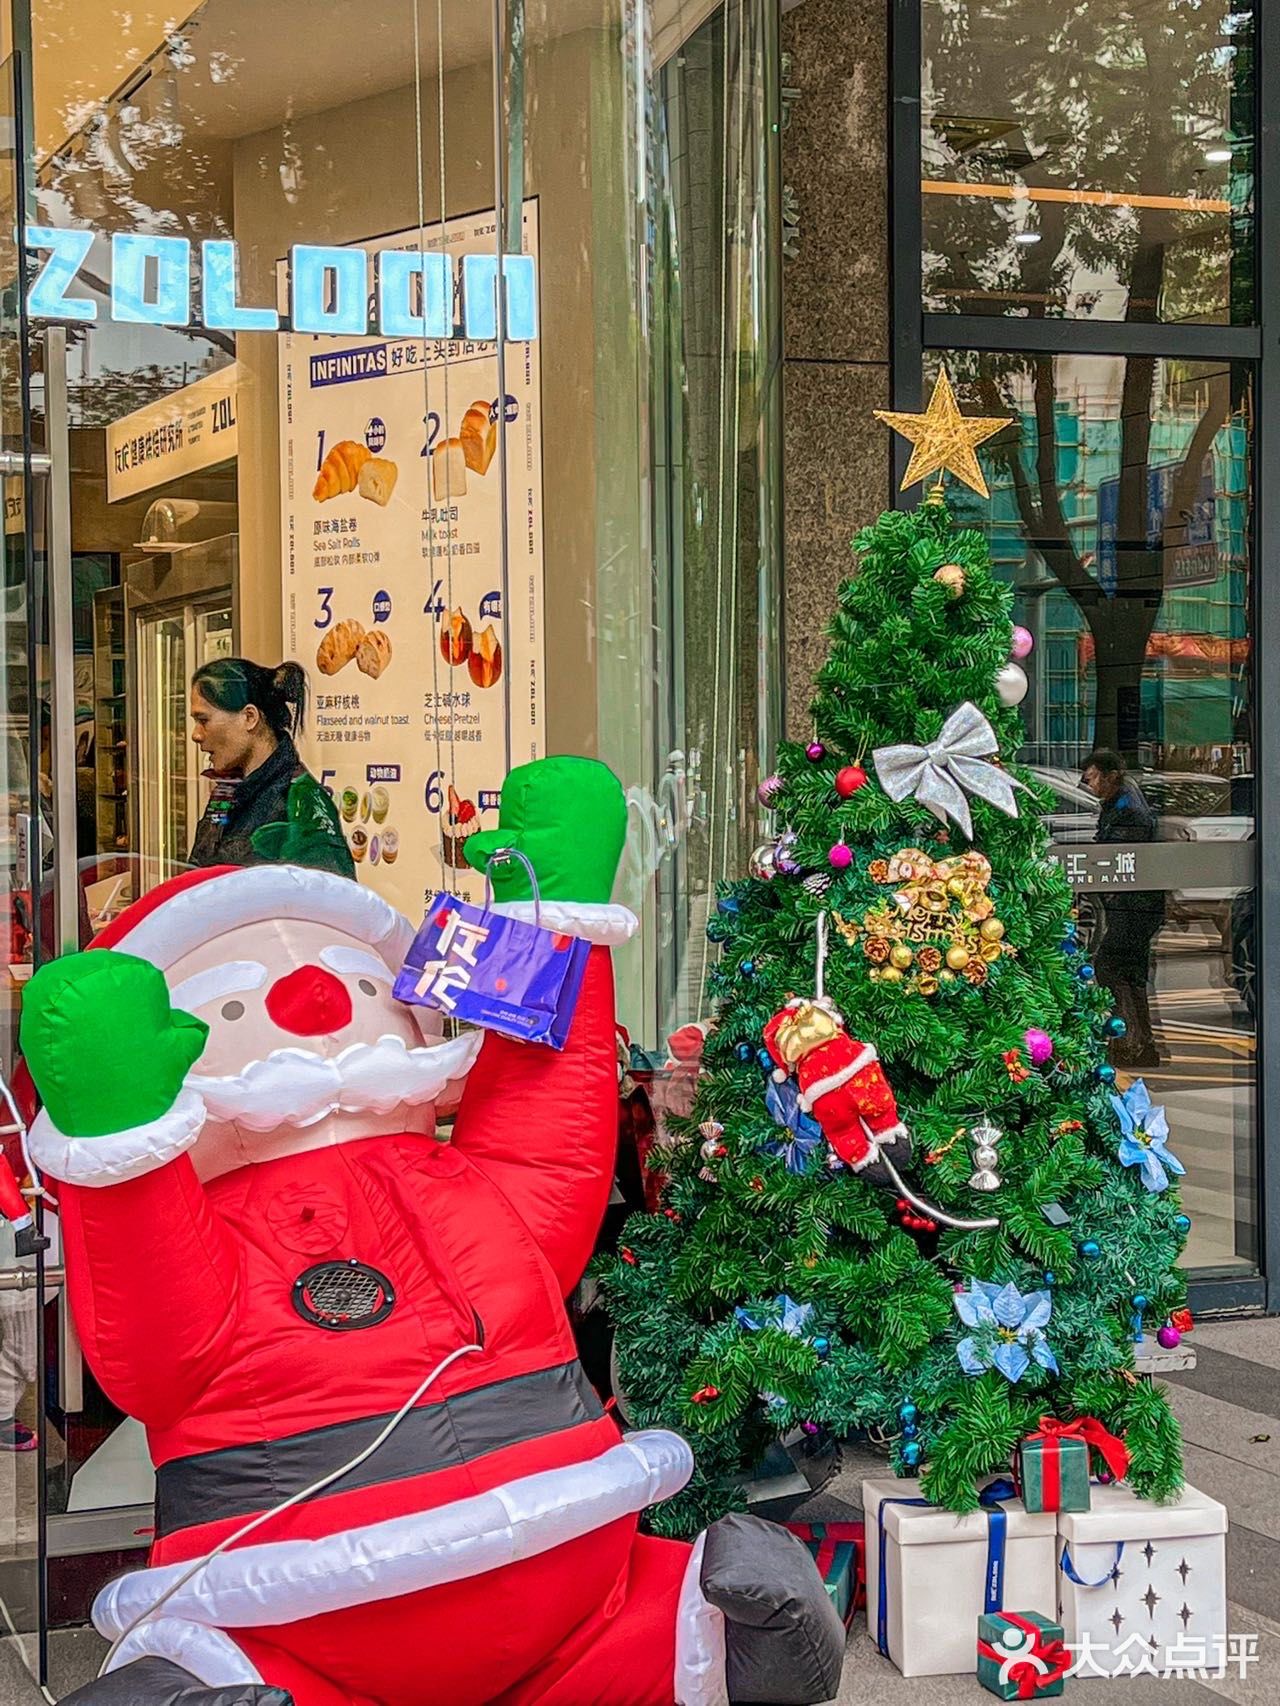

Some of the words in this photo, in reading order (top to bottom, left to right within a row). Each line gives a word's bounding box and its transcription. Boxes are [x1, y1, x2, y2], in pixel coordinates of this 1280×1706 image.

[311, 350, 386, 382] INFINITAS
[420, 411, 441, 457] 2
[317, 430, 326, 472] 1
[421, 506, 459, 523] 牛乳吐司
[313, 518, 357, 535] 原味海盐卷
[314, 587, 334, 629] 3
[423, 580, 446, 623] 4
[316, 695, 360, 710] 亚麻籽核桃
[424, 692, 471, 708] 芝士碱水球
[316, 714, 347, 726] Flaxseed
[348, 714, 363, 725] and
[365, 714, 389, 725] walnut
[391, 714, 410, 725] toast
[454, 712, 480, 725] Pretzel
[425, 770, 446, 814] 6
[1067, 852, 1136, 875] 汇一城
[1067, 875, 1093, 884] ONE
[1101, 874, 1136, 883] MALL
